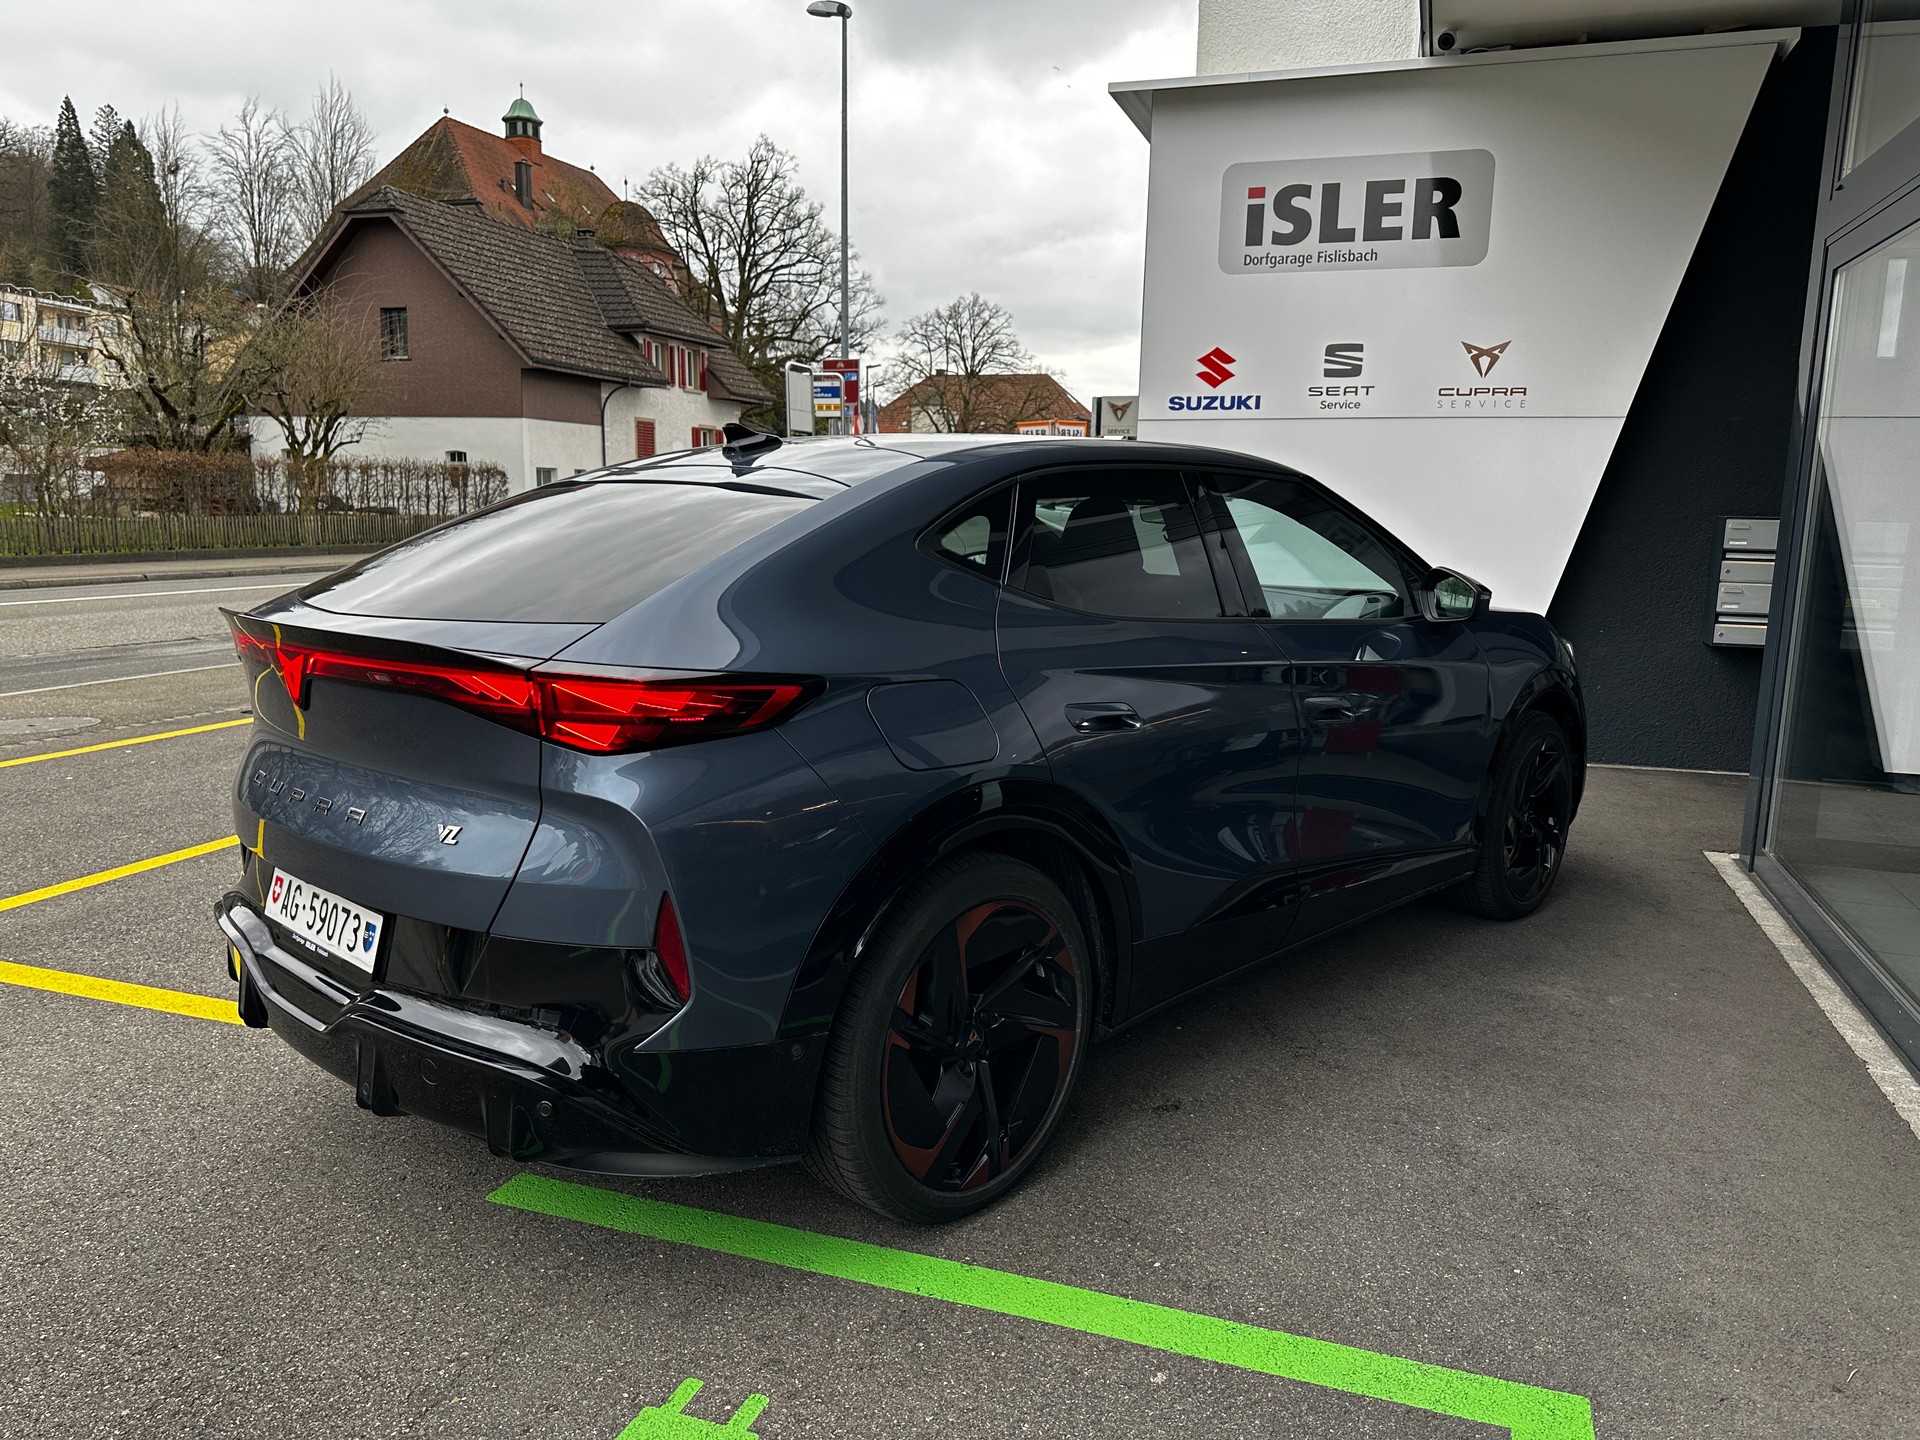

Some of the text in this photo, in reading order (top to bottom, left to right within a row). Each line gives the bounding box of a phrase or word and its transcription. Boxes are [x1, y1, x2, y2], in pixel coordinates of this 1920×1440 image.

[1243, 248, 1378, 268] Dorfgarage Fislisbach
[1308, 385, 1375, 397] SEAT
[1438, 386, 1527, 397] CUPRA
[1168, 394, 1261, 411] SUZUKI
[1319, 399, 1361, 410] Service
[1437, 399, 1527, 409] SERVICE
[253, 769, 367, 826] CUPRA
